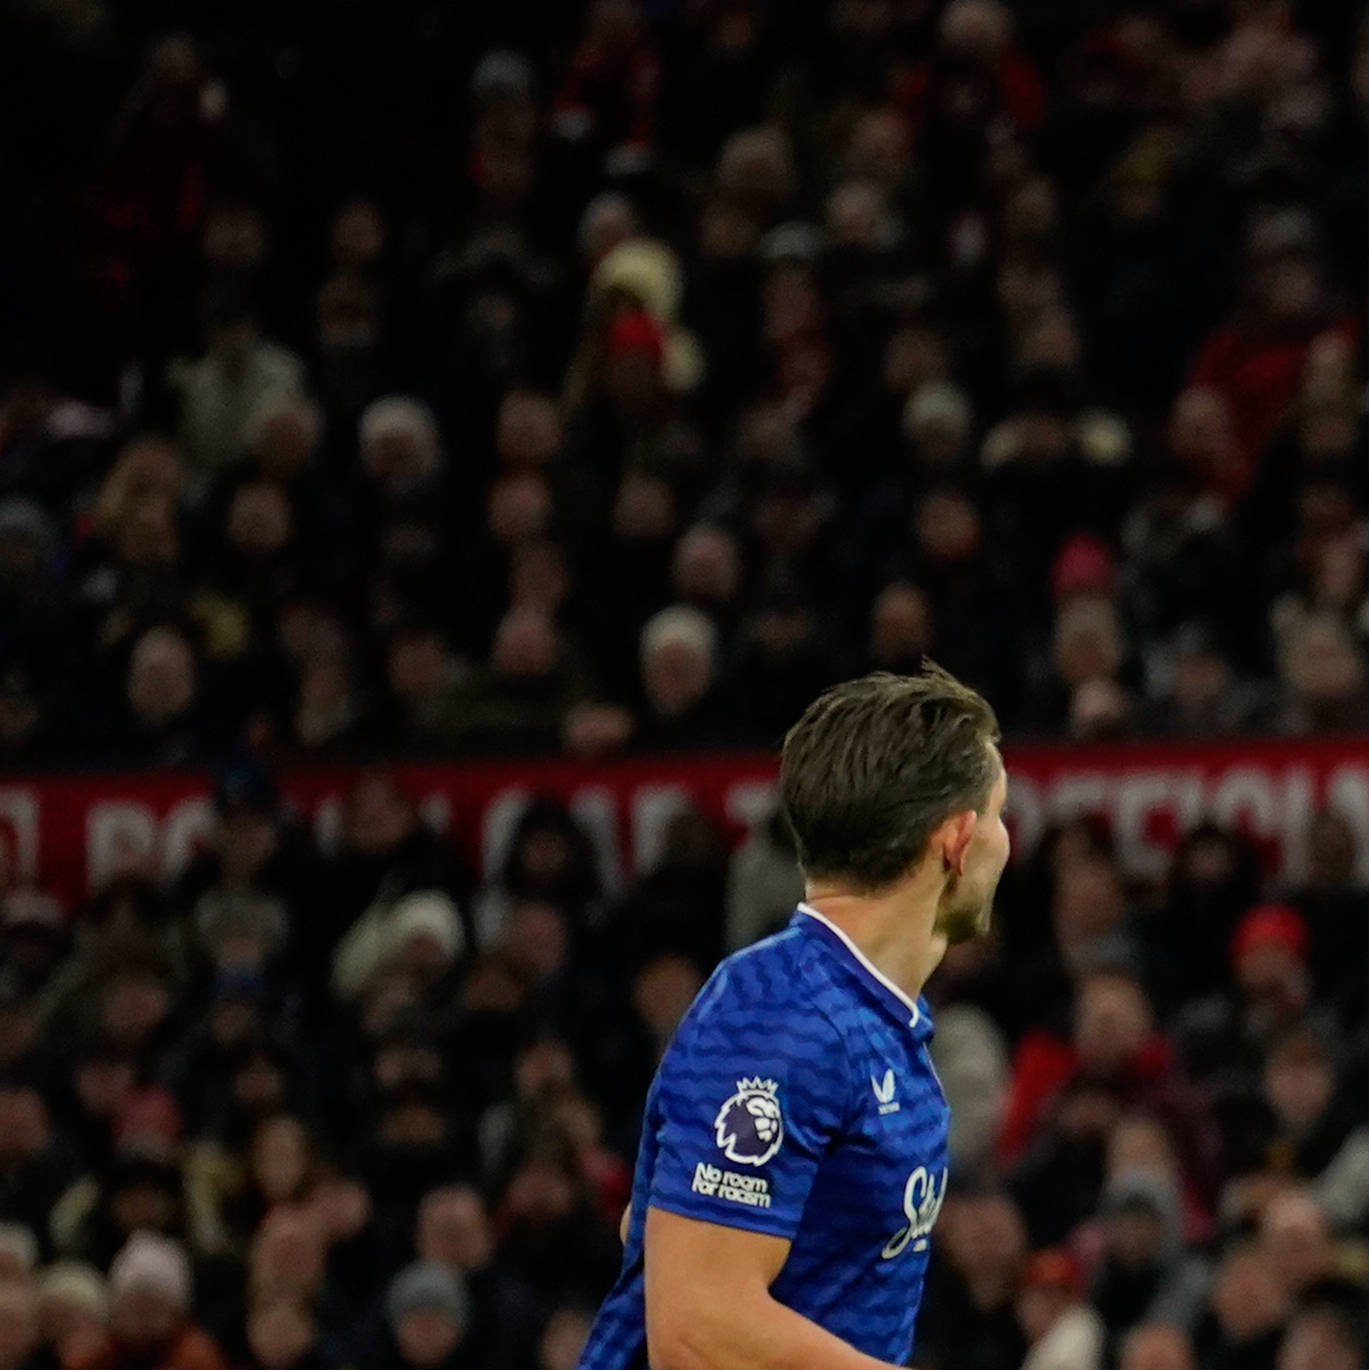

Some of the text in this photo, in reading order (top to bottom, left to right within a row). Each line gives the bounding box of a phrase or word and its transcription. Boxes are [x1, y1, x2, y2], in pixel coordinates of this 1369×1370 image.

[694, 1162, 768, 1193] No room
[691, 1179, 771, 1208] for racism
